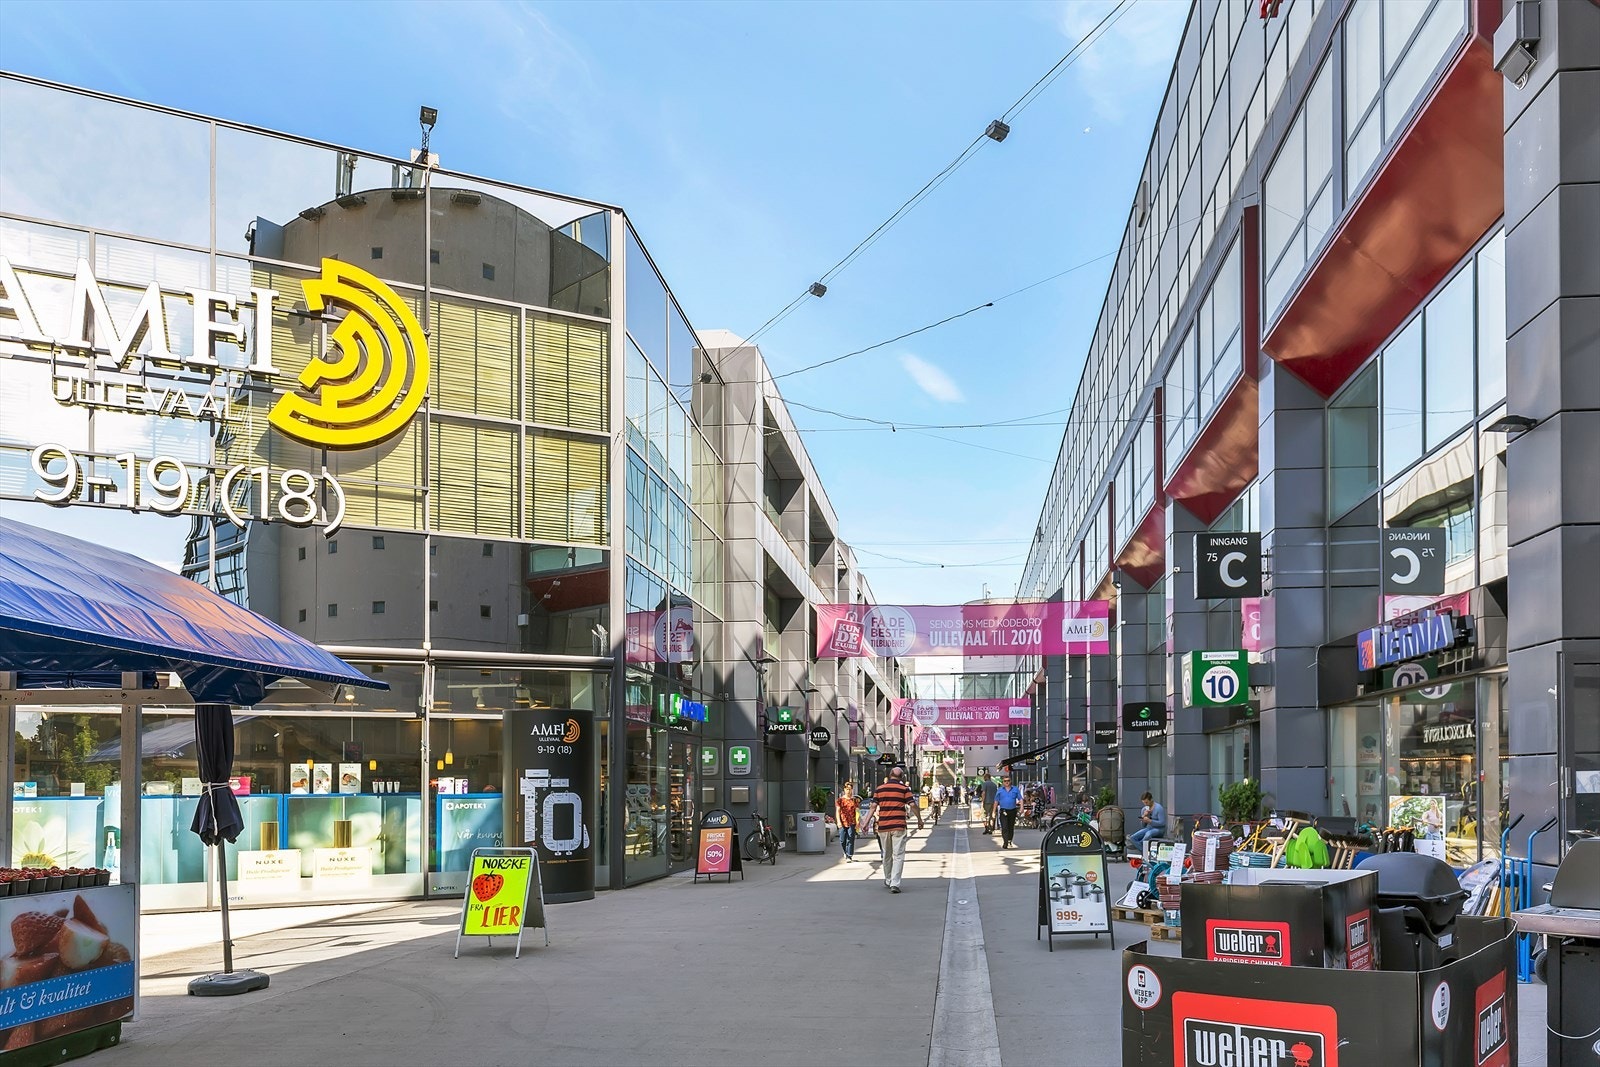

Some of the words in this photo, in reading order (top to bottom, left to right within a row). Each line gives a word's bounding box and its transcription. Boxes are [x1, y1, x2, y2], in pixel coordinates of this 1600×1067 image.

[30, 443, 190, 512] 9-19
[220, 463, 346, 539] (18)
[1210, 537, 1248, 546] INNGANG
[1206, 553, 1218, 562] 75
[1219, 551, 1248, 588] C
[889, 617, 905, 627] DE
[929, 620, 954, 629] SEND
[956, 619, 974, 629] SMS
[976, 619, 996, 628] MED
[998, 617, 1042, 628] KODEORD
[870, 629, 905, 638] BESTE
[1066, 624, 1092, 635] AMFI
[836, 631, 860, 645] DE
[929, 630, 988, 647] ULLEVAAL
[991, 630, 1008, 646] TIL
[1011, 628, 1042, 645] 2070
[1206, 675, 1235, 699] 10
[945, 711, 974, 720] ULLEVAAL
[984, 711, 1000, 720] 2070
[1131, 719, 1159, 727] stamina
[530, 723, 565, 736] AMFI
[1012, 739, 1020, 748] D
[537, 745, 555, 754] 9-19
[557, 745, 573, 755] (18)
[1055, 834, 1081, 845] AMFI
[706, 850, 723, 858] 50%
[482, 858, 528, 870] NORSKE
[470, 903, 484, 911] FRA
[480, 905, 521, 927] LIER
[1218, 929, 1264, 953] weber
[20, 991, 37, 1010] &
[38, 981, 92, 1006] kvalitet
[1192, 1024, 1287, 1067] weber
